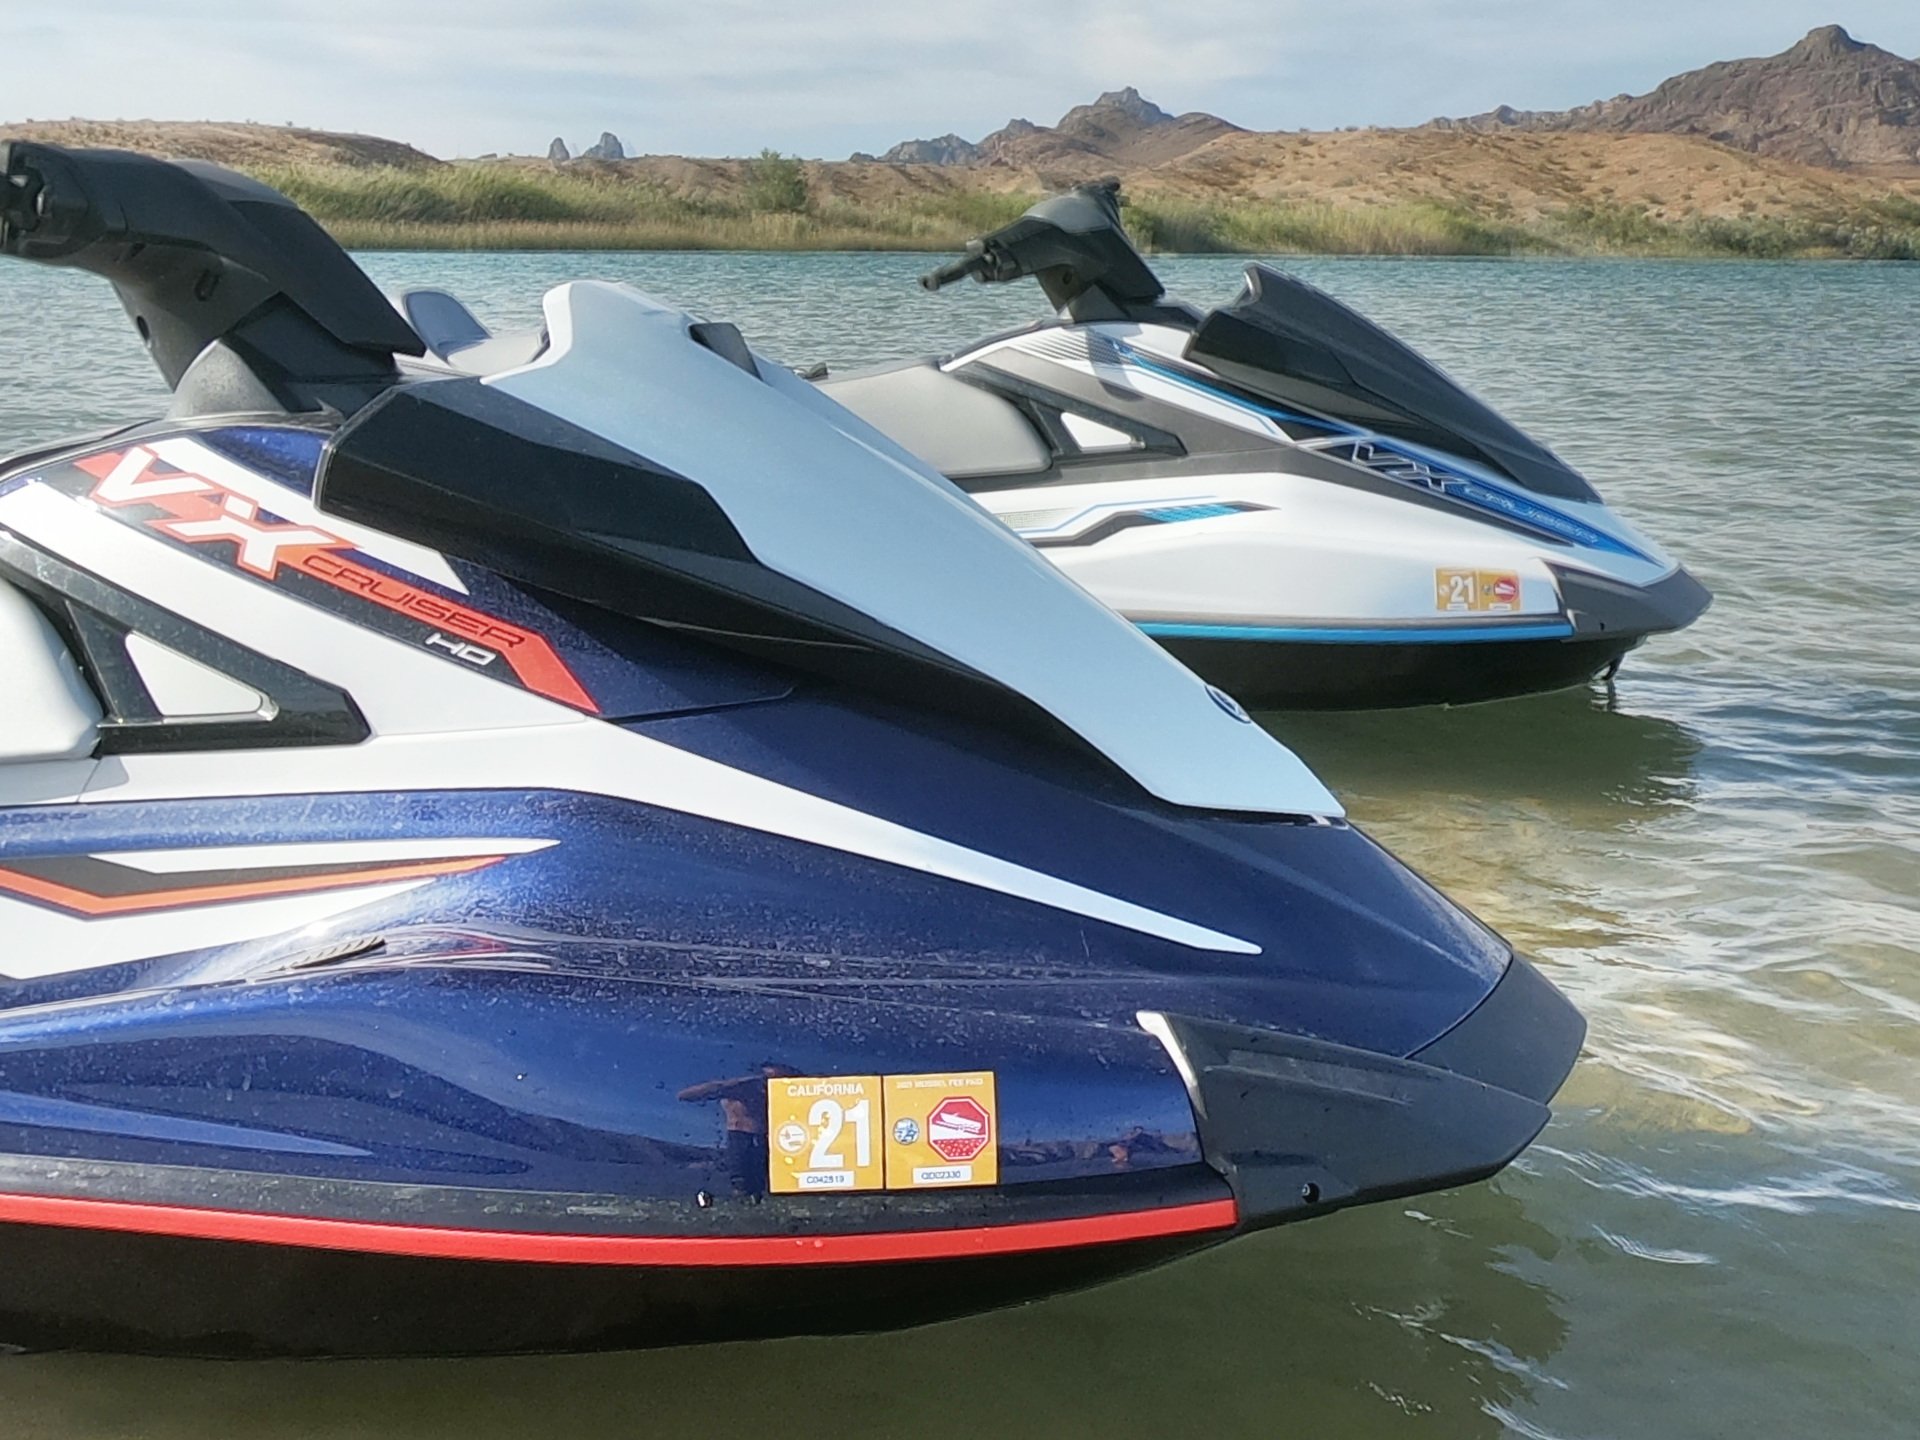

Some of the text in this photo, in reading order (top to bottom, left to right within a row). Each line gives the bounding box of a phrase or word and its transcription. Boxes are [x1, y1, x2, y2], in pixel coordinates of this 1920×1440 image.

[303, 555, 526, 650] CRUISER
[1450, 575, 1475, 603] 21
[787, 1082, 864, 1096] CALIFORNIA
[808, 1099, 871, 1168] 21
